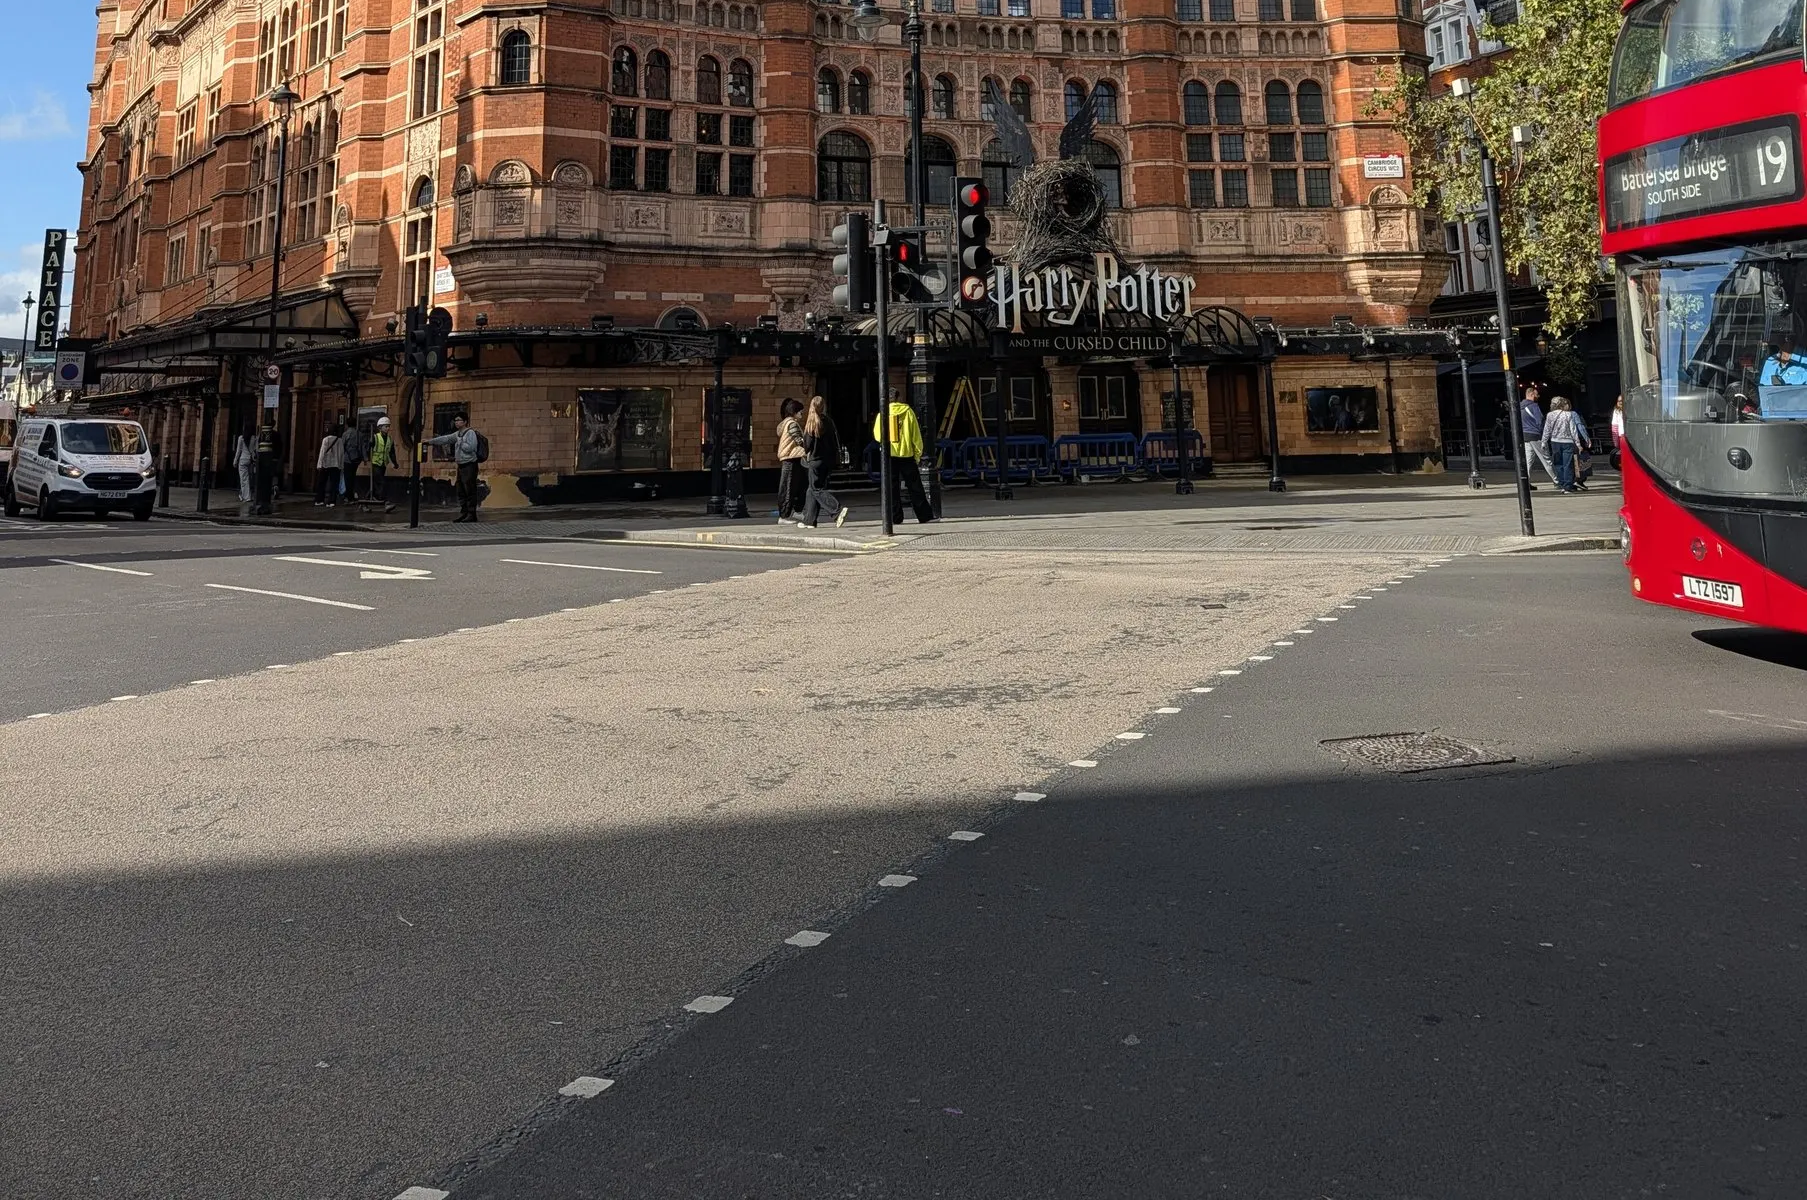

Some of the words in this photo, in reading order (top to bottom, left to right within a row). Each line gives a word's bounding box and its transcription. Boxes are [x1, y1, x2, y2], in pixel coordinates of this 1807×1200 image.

[1621, 163, 1680, 191] Battersea
[1683, 152, 1727, 181] Bridge
[1756, 135, 1787, 186] 19
[1648, 187, 1680, 205] SOUTH
[1681, 183, 1702, 198] SIDE
[38, 231, 63, 348] PALACE
[988, 260, 1091, 334] Harry
[1093, 252, 1197, 330] Potter
[1009, 339, 1030, 348] AND
[1032, 339, 1050, 348] THE
[1054, 336, 1114, 351] CURSED
[1118, 336, 1167, 350] CHILD
[269, 367, 279, 376] 20
[1688, 578, 1710, 598] LTZ
[1711, 582, 1735, 602] 1597
